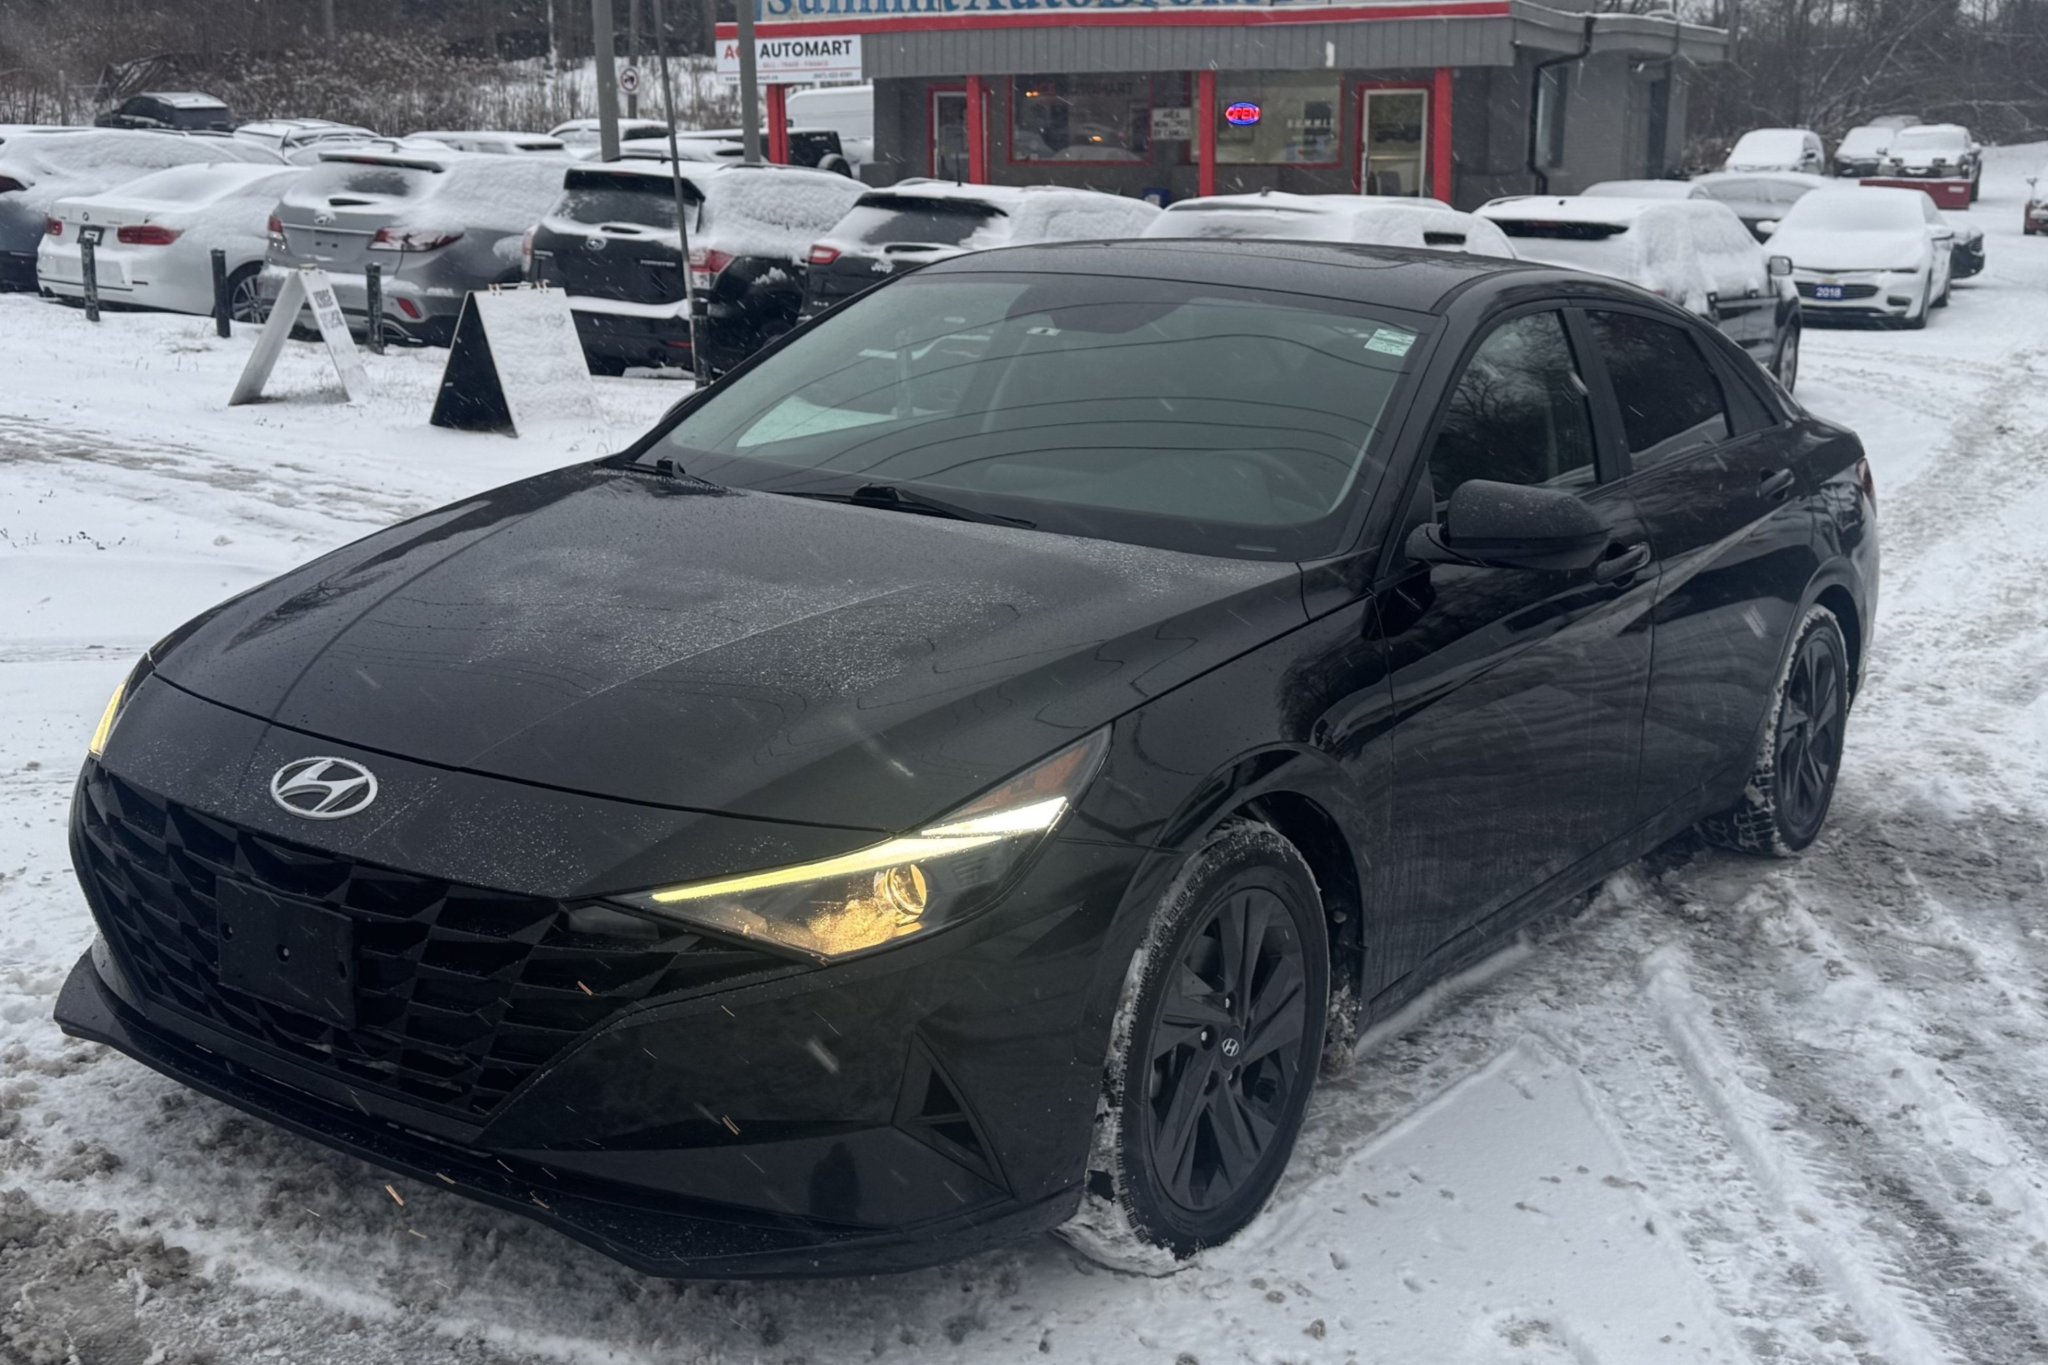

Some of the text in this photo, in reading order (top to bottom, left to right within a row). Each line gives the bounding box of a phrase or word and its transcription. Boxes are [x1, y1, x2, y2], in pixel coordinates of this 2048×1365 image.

[760, 40, 852, 58] AUTOMART
[1225, 106, 1260, 121] OPEN
[1815, 286, 1842, 298] 2018
